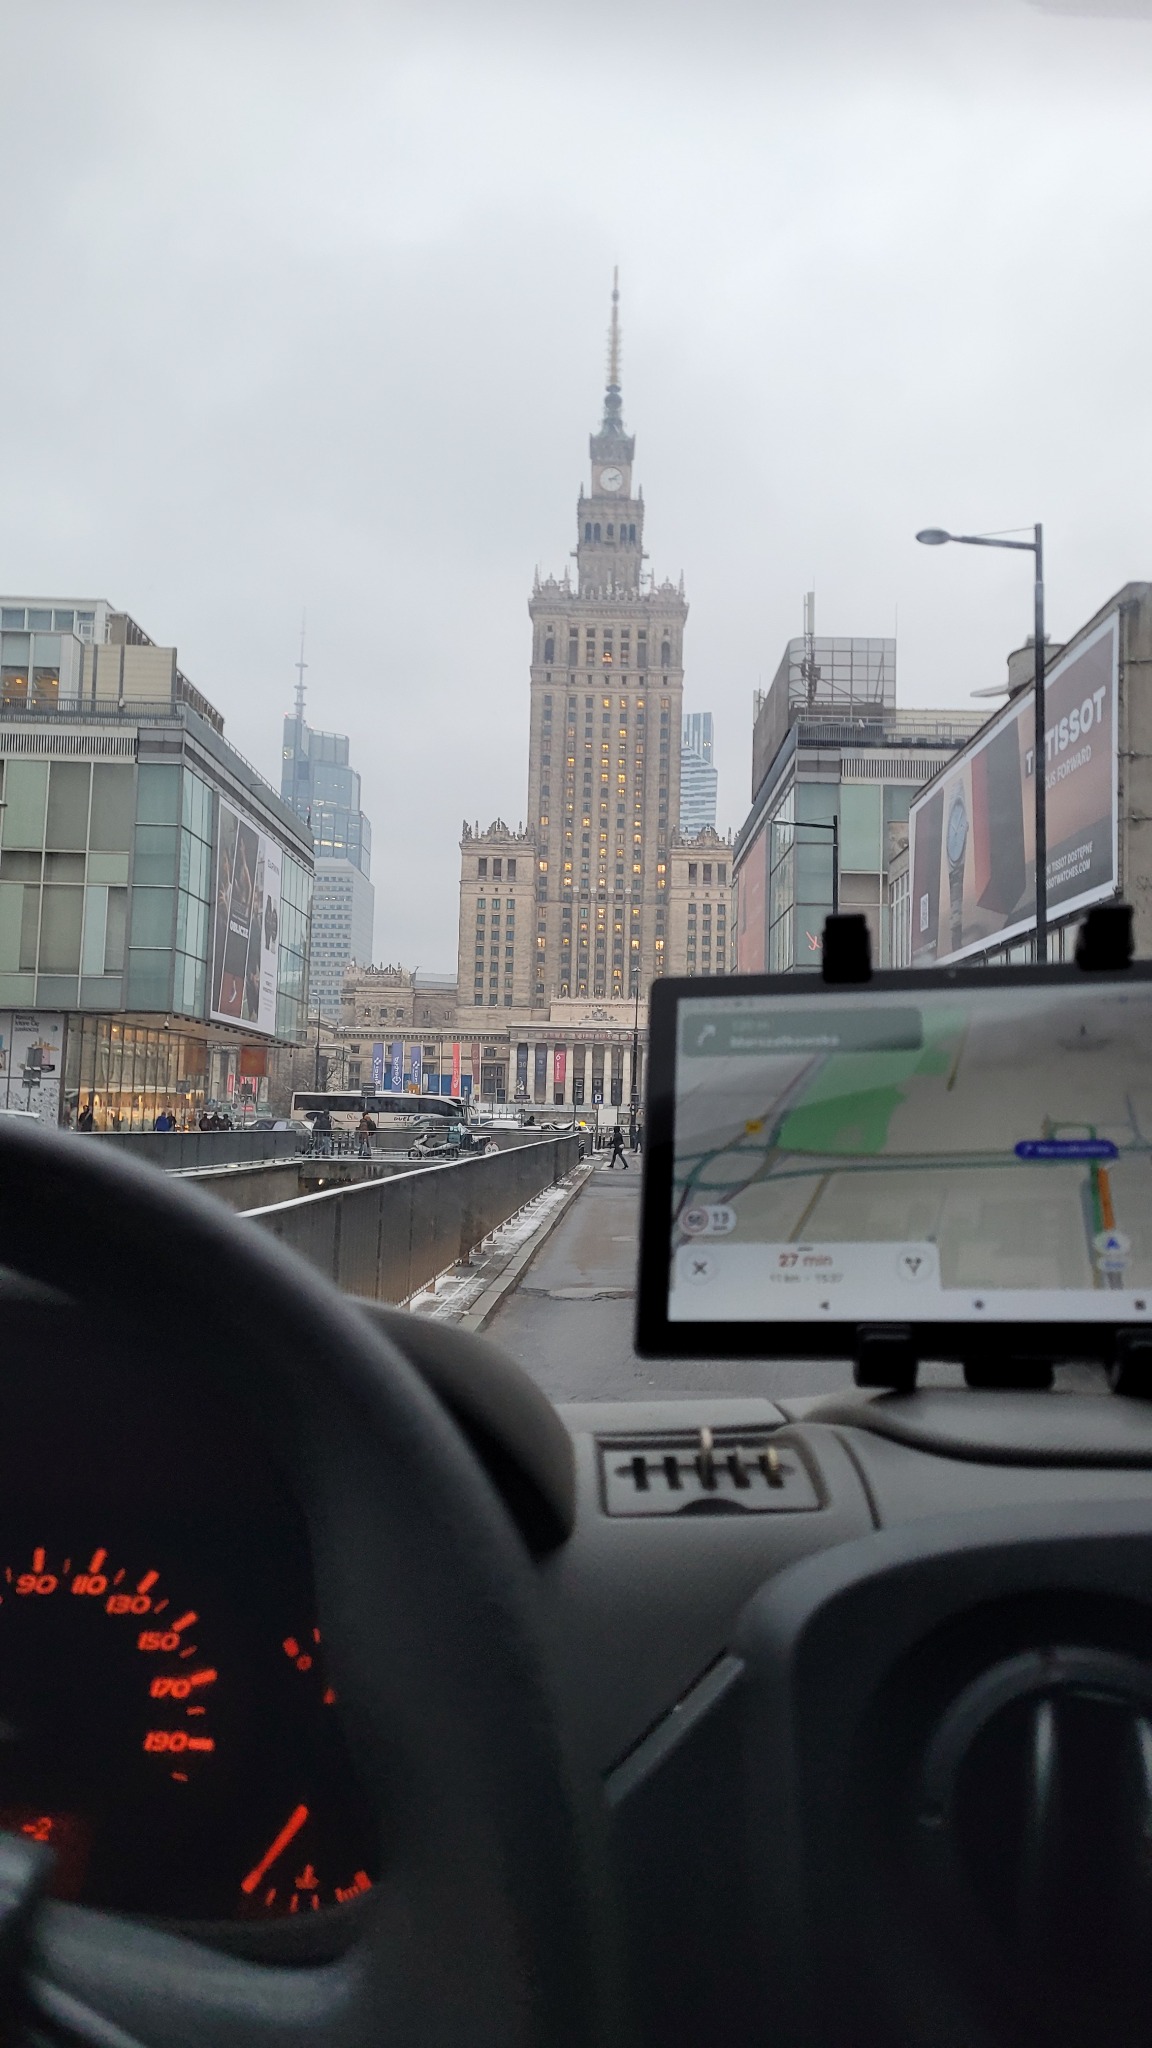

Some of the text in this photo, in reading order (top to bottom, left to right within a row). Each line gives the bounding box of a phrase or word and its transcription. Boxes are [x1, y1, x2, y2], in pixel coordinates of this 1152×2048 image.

[1045, 685, 1106, 761] TISSOT
[1057, 744, 1092, 781] FORWARD
[594, 1094, 602, 1104] P
[16, 1573, 58, 1595] 90
[71, 1573, 108, 1595] 110
[106, 1594, 151, 1615] 130
[138, 1630, 180, 1651] 150
[144, 1730, 190, 1752] 190
